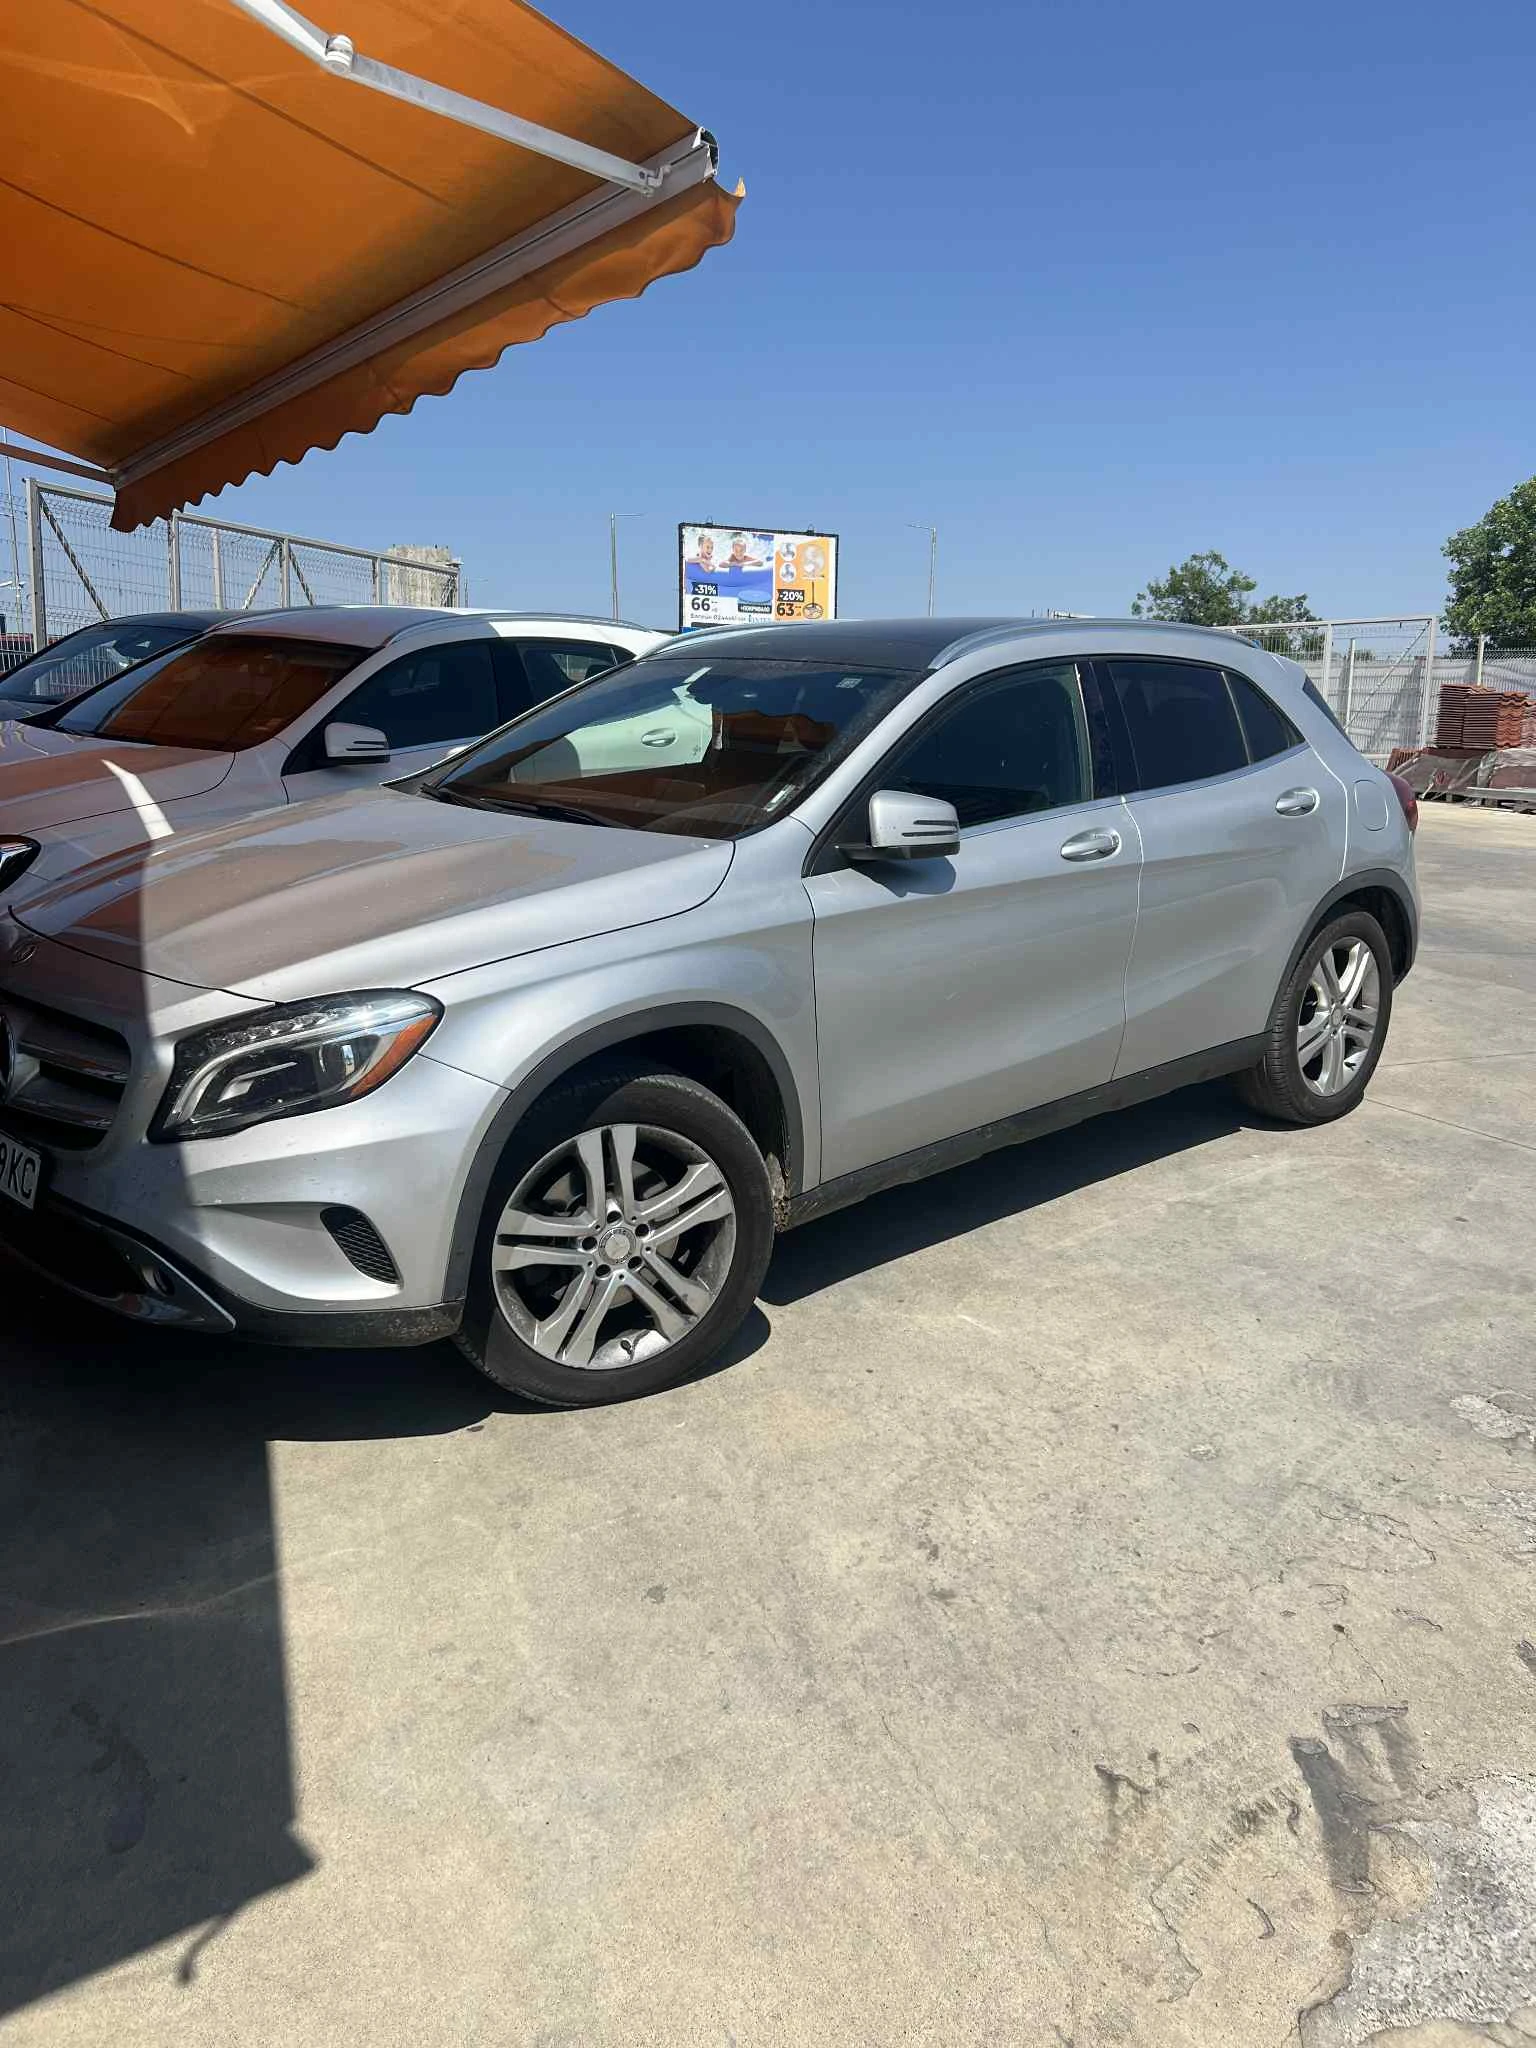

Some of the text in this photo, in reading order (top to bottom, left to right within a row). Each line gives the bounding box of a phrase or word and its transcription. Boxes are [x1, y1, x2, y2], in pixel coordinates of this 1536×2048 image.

[695, 584, 717, 595] -31%
[780, 591, 804, 601] -20%
[691, 597, 711, 612] 66
[777, 602, 795, 616] 63
